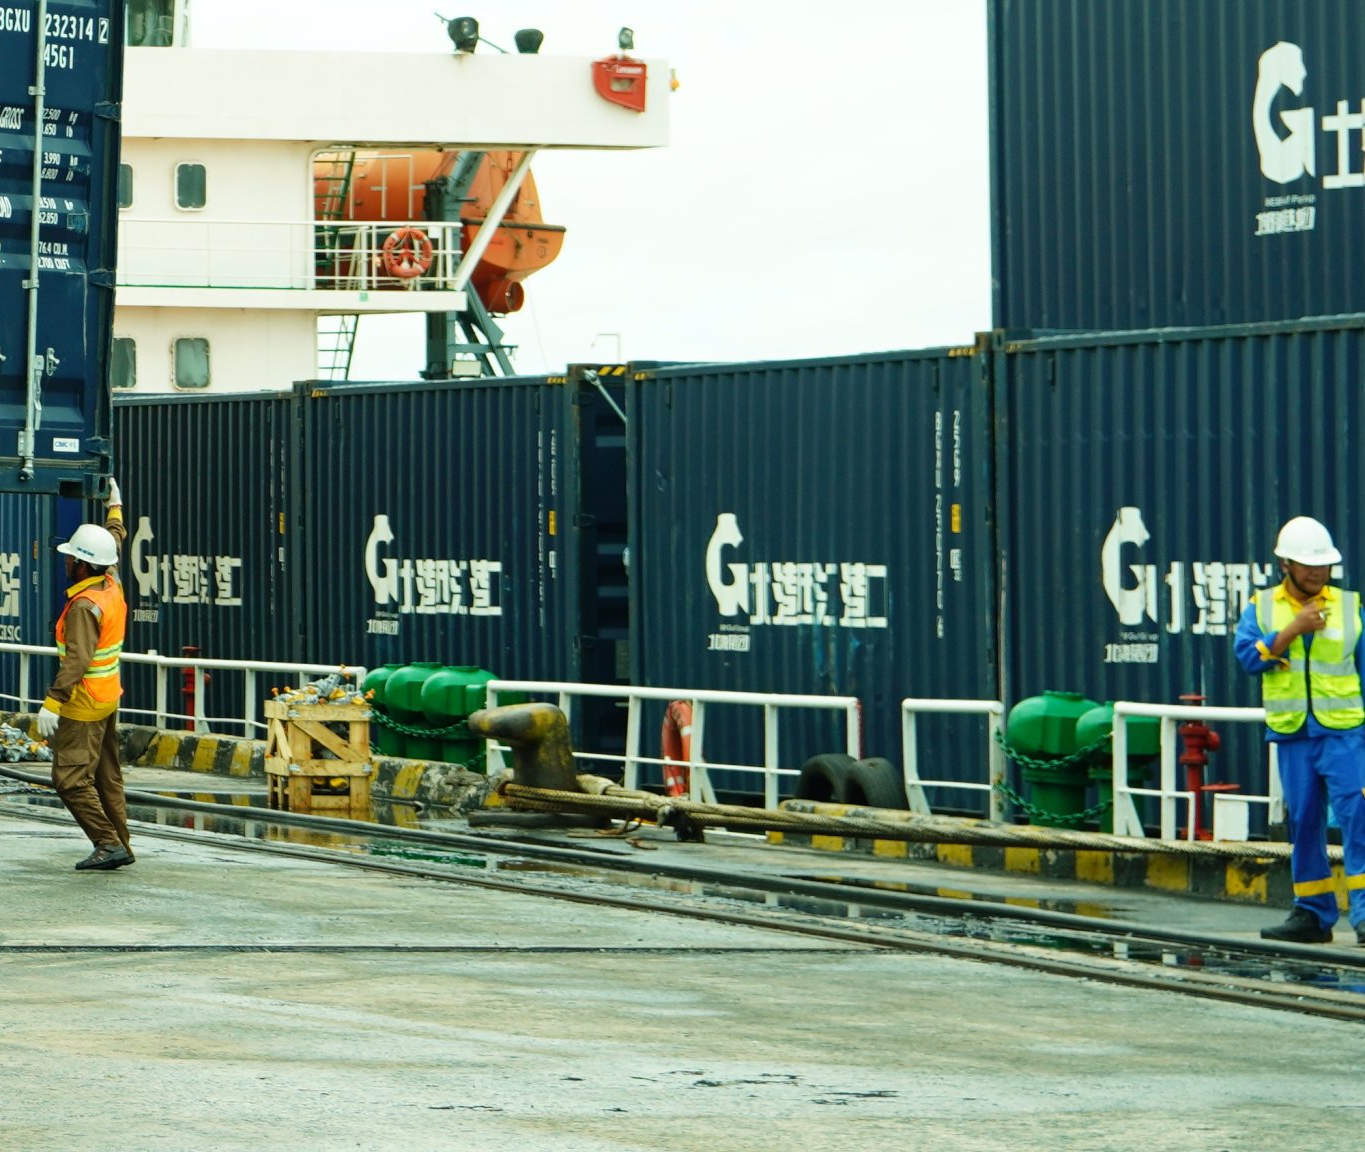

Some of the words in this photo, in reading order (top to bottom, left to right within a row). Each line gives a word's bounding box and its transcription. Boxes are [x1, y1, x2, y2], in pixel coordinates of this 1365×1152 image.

[44, 13, 94, 42] 232314
[99, 18, 109, 43] 2
[44, 43, 74, 70] 45G1
[0, 106, 25, 130] GROSS
[42, 107, 61, 121] 2.500
[65, 125, 74, 138] lb
